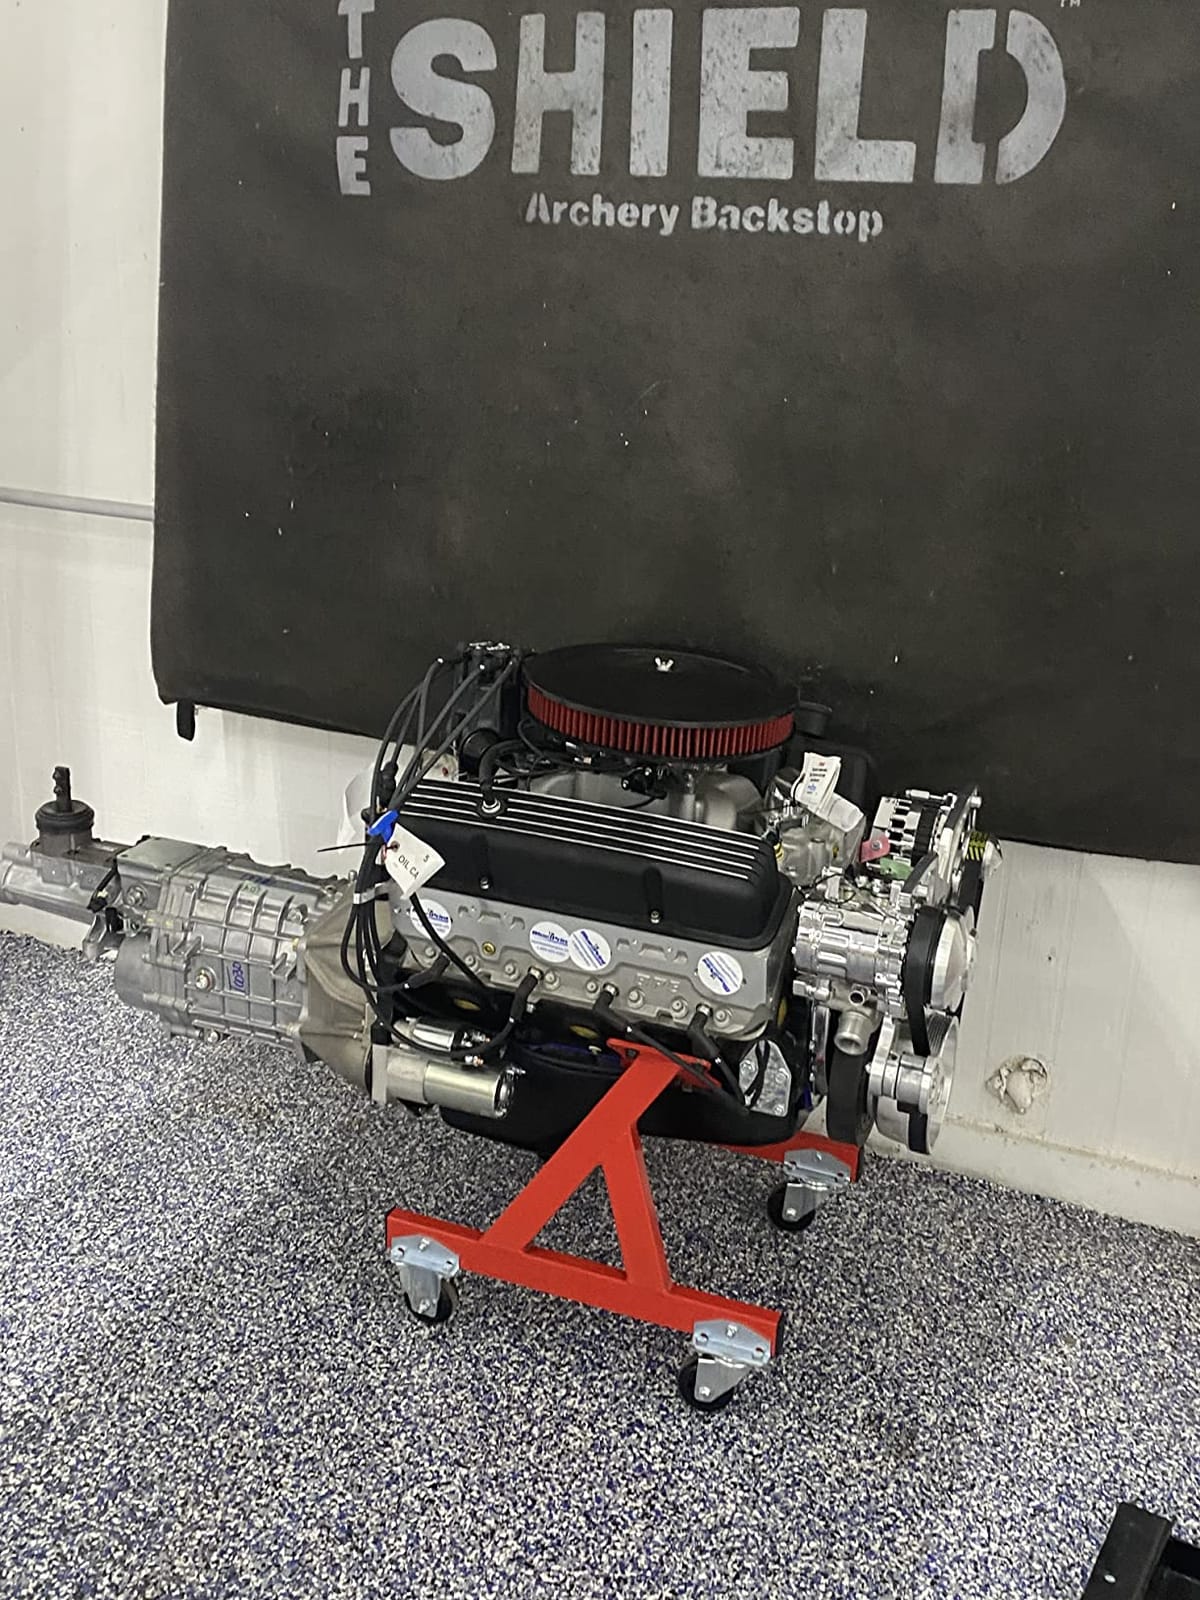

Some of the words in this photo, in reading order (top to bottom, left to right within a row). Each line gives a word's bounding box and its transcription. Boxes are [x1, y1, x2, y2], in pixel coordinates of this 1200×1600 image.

[336, 0, 375, 196] THE
[389, 6, 1067, 185] SHIELD
[525, 193, 680, 236] Archery
[691, 195, 884, 242] Backstop
[398, 854, 410, 870] OIL
